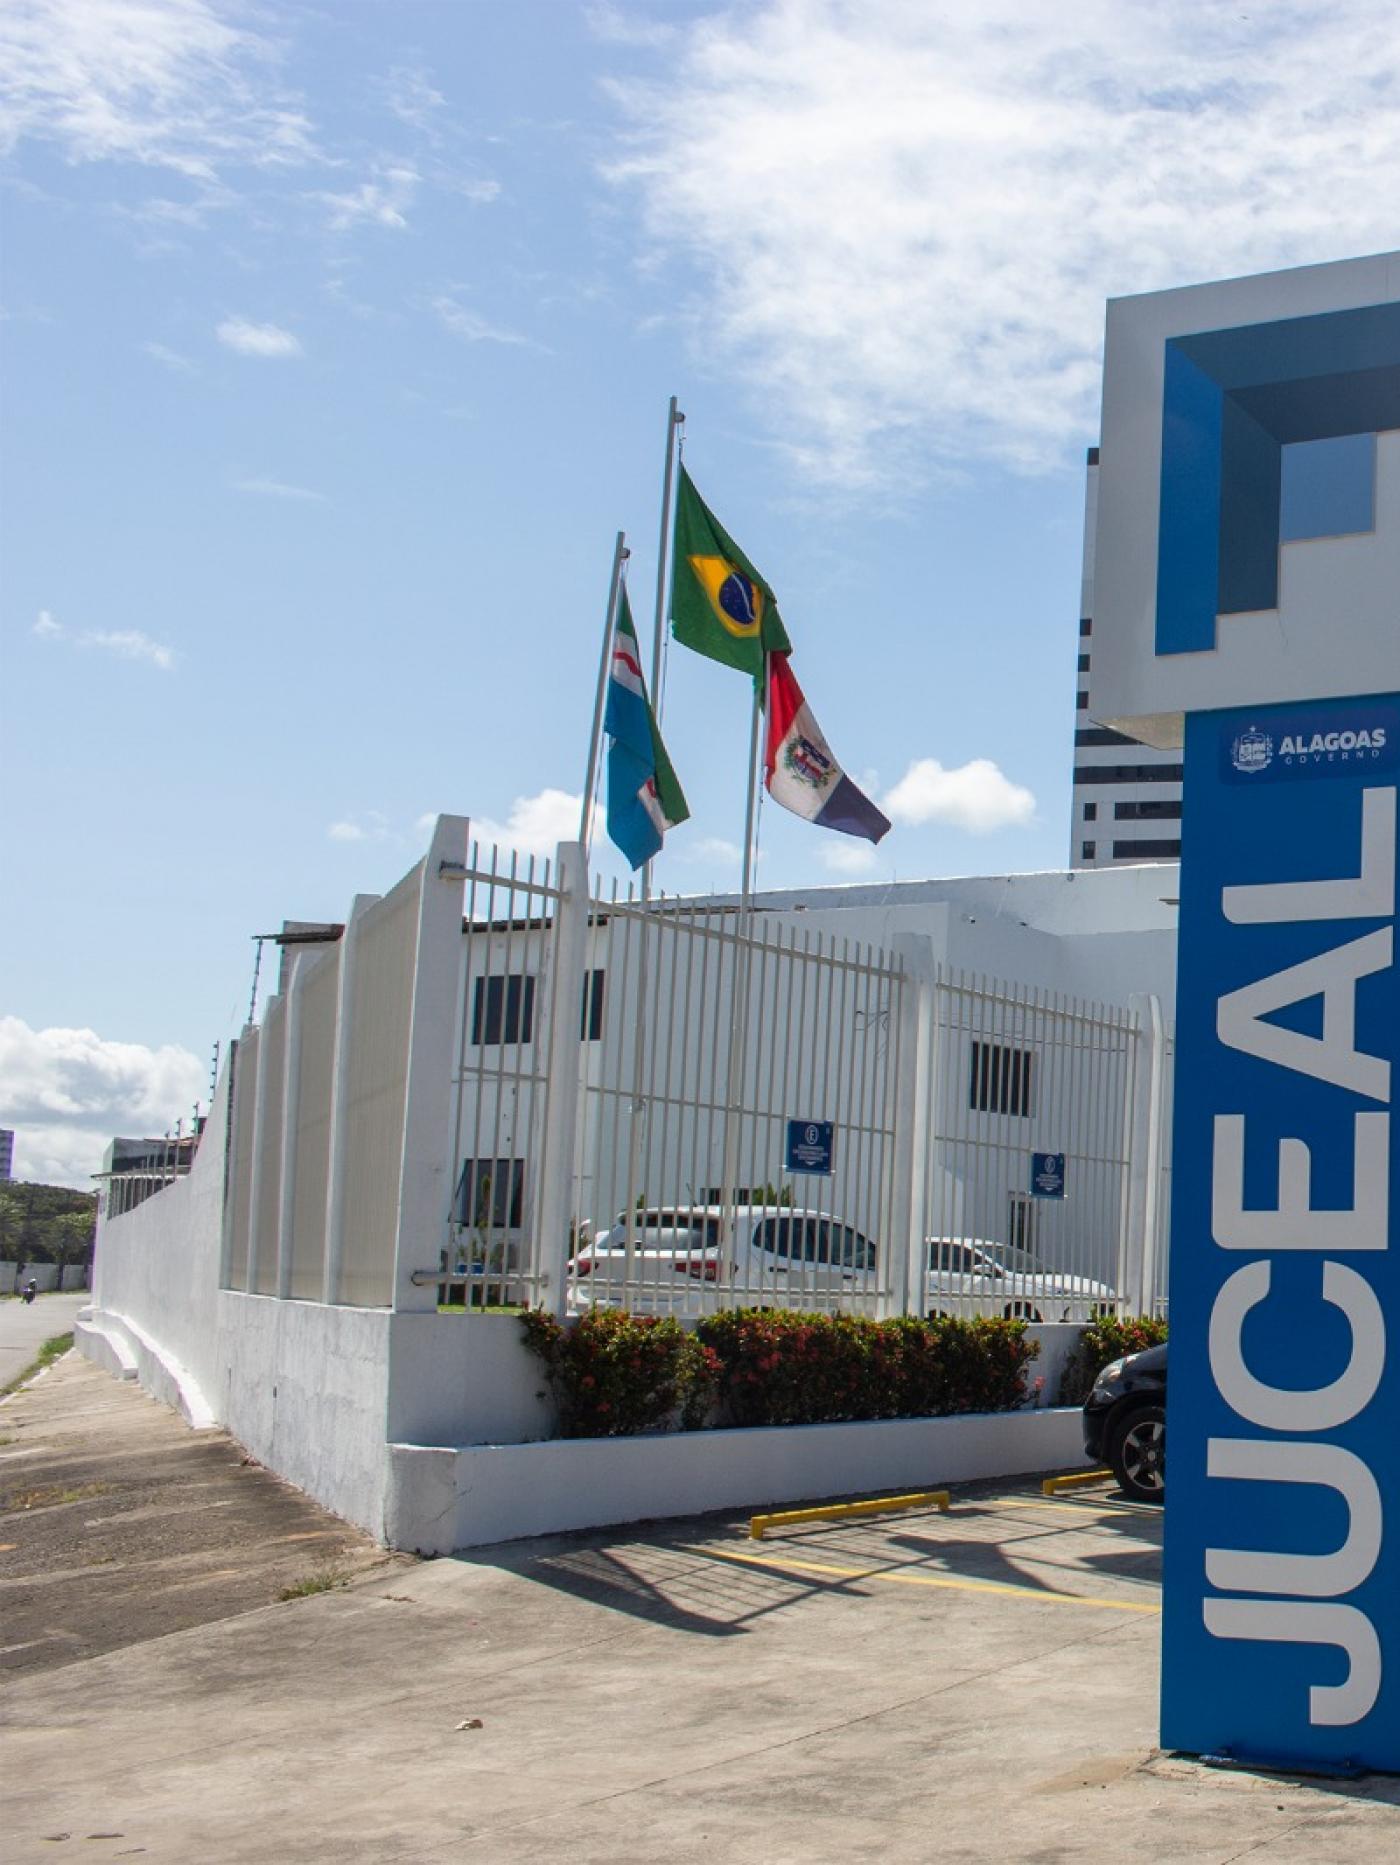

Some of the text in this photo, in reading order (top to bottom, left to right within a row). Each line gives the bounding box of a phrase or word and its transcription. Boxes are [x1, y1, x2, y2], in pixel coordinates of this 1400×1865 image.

[1279, 728, 1386, 754] ALAGOAS
[1285, 750, 1379, 765] GOVERNO
[1203, 786, 1397, 1726] JUCEAL
